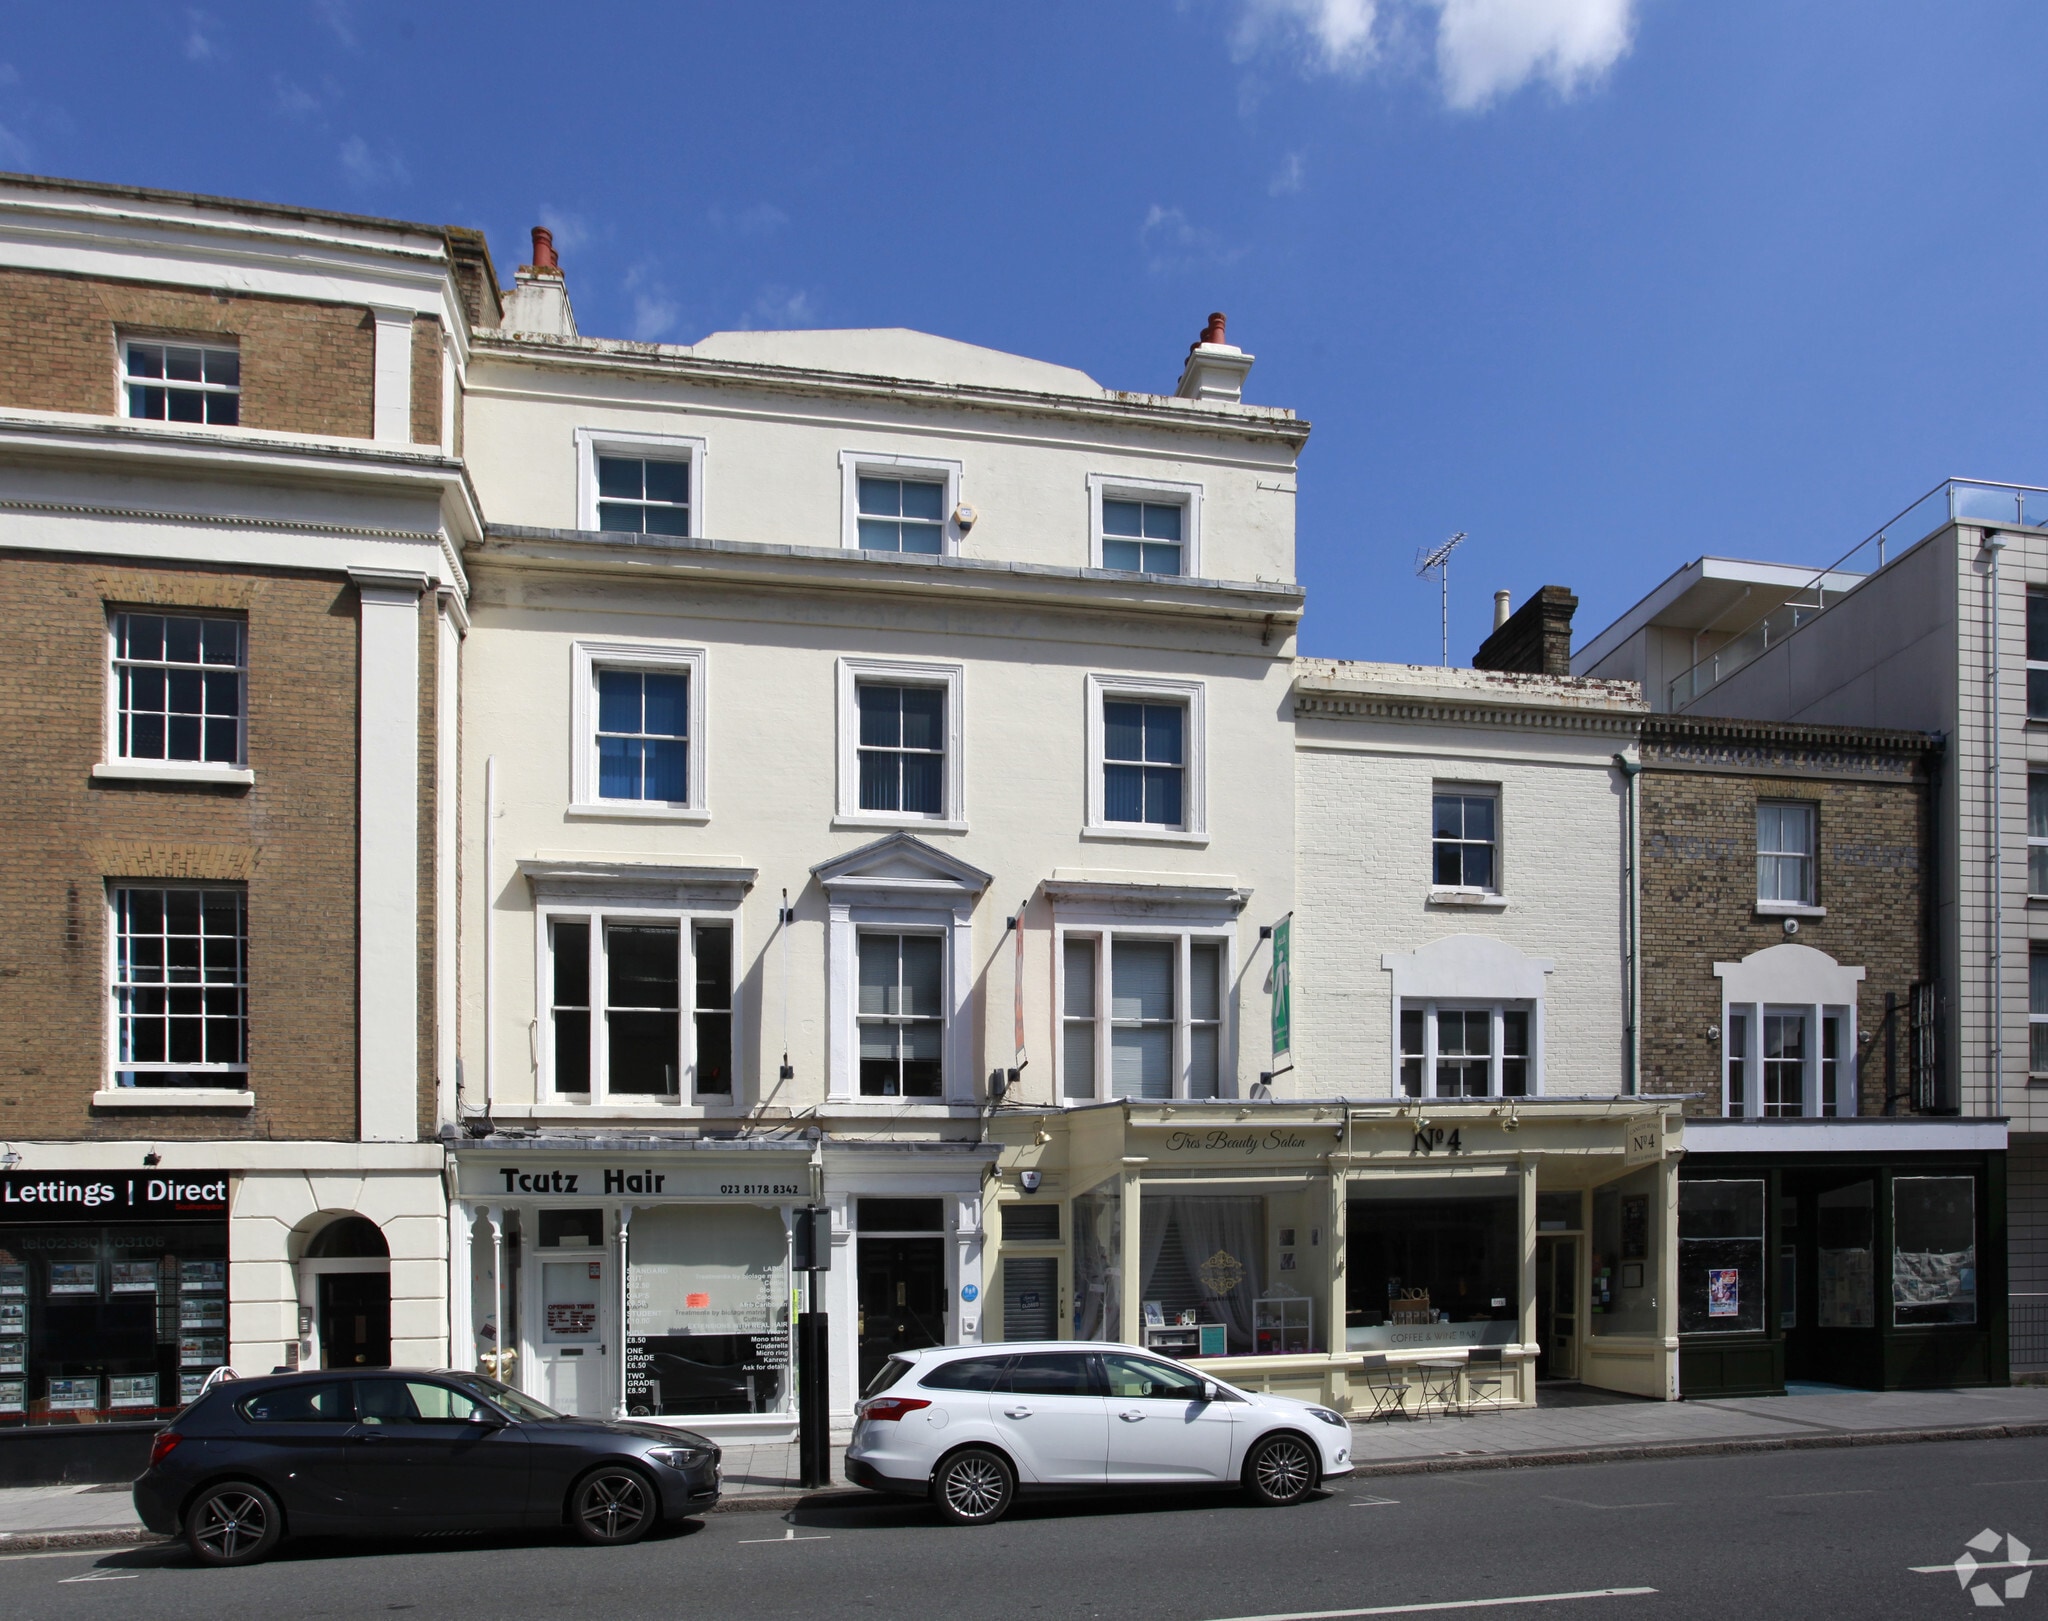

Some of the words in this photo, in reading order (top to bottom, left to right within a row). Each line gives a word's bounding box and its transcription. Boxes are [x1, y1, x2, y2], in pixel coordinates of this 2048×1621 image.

[1166, 1131, 1200, 1151] Tres
[1205, 1130, 1258, 1155] Beauty
[1262, 1129, 1306, 1150] Salon
[1447, 1128, 1462, 1151] 4
[5, 1181, 115, 1206] Lettings
[147, 1180, 226, 1201] Direct
[499, 1168, 579, 1194] Tcutz
[603, 1168, 666, 1195] Hair
[720, 1184, 740, 1194] 023
[743, 1184, 771, 1194] 8178
[773, 1184, 799, 1194] 8342
[1391, 1333, 1422, 1342] COFFEE
[1425, 1333, 1431, 1341] &
[1434, 1331, 1456, 1341] WINE
